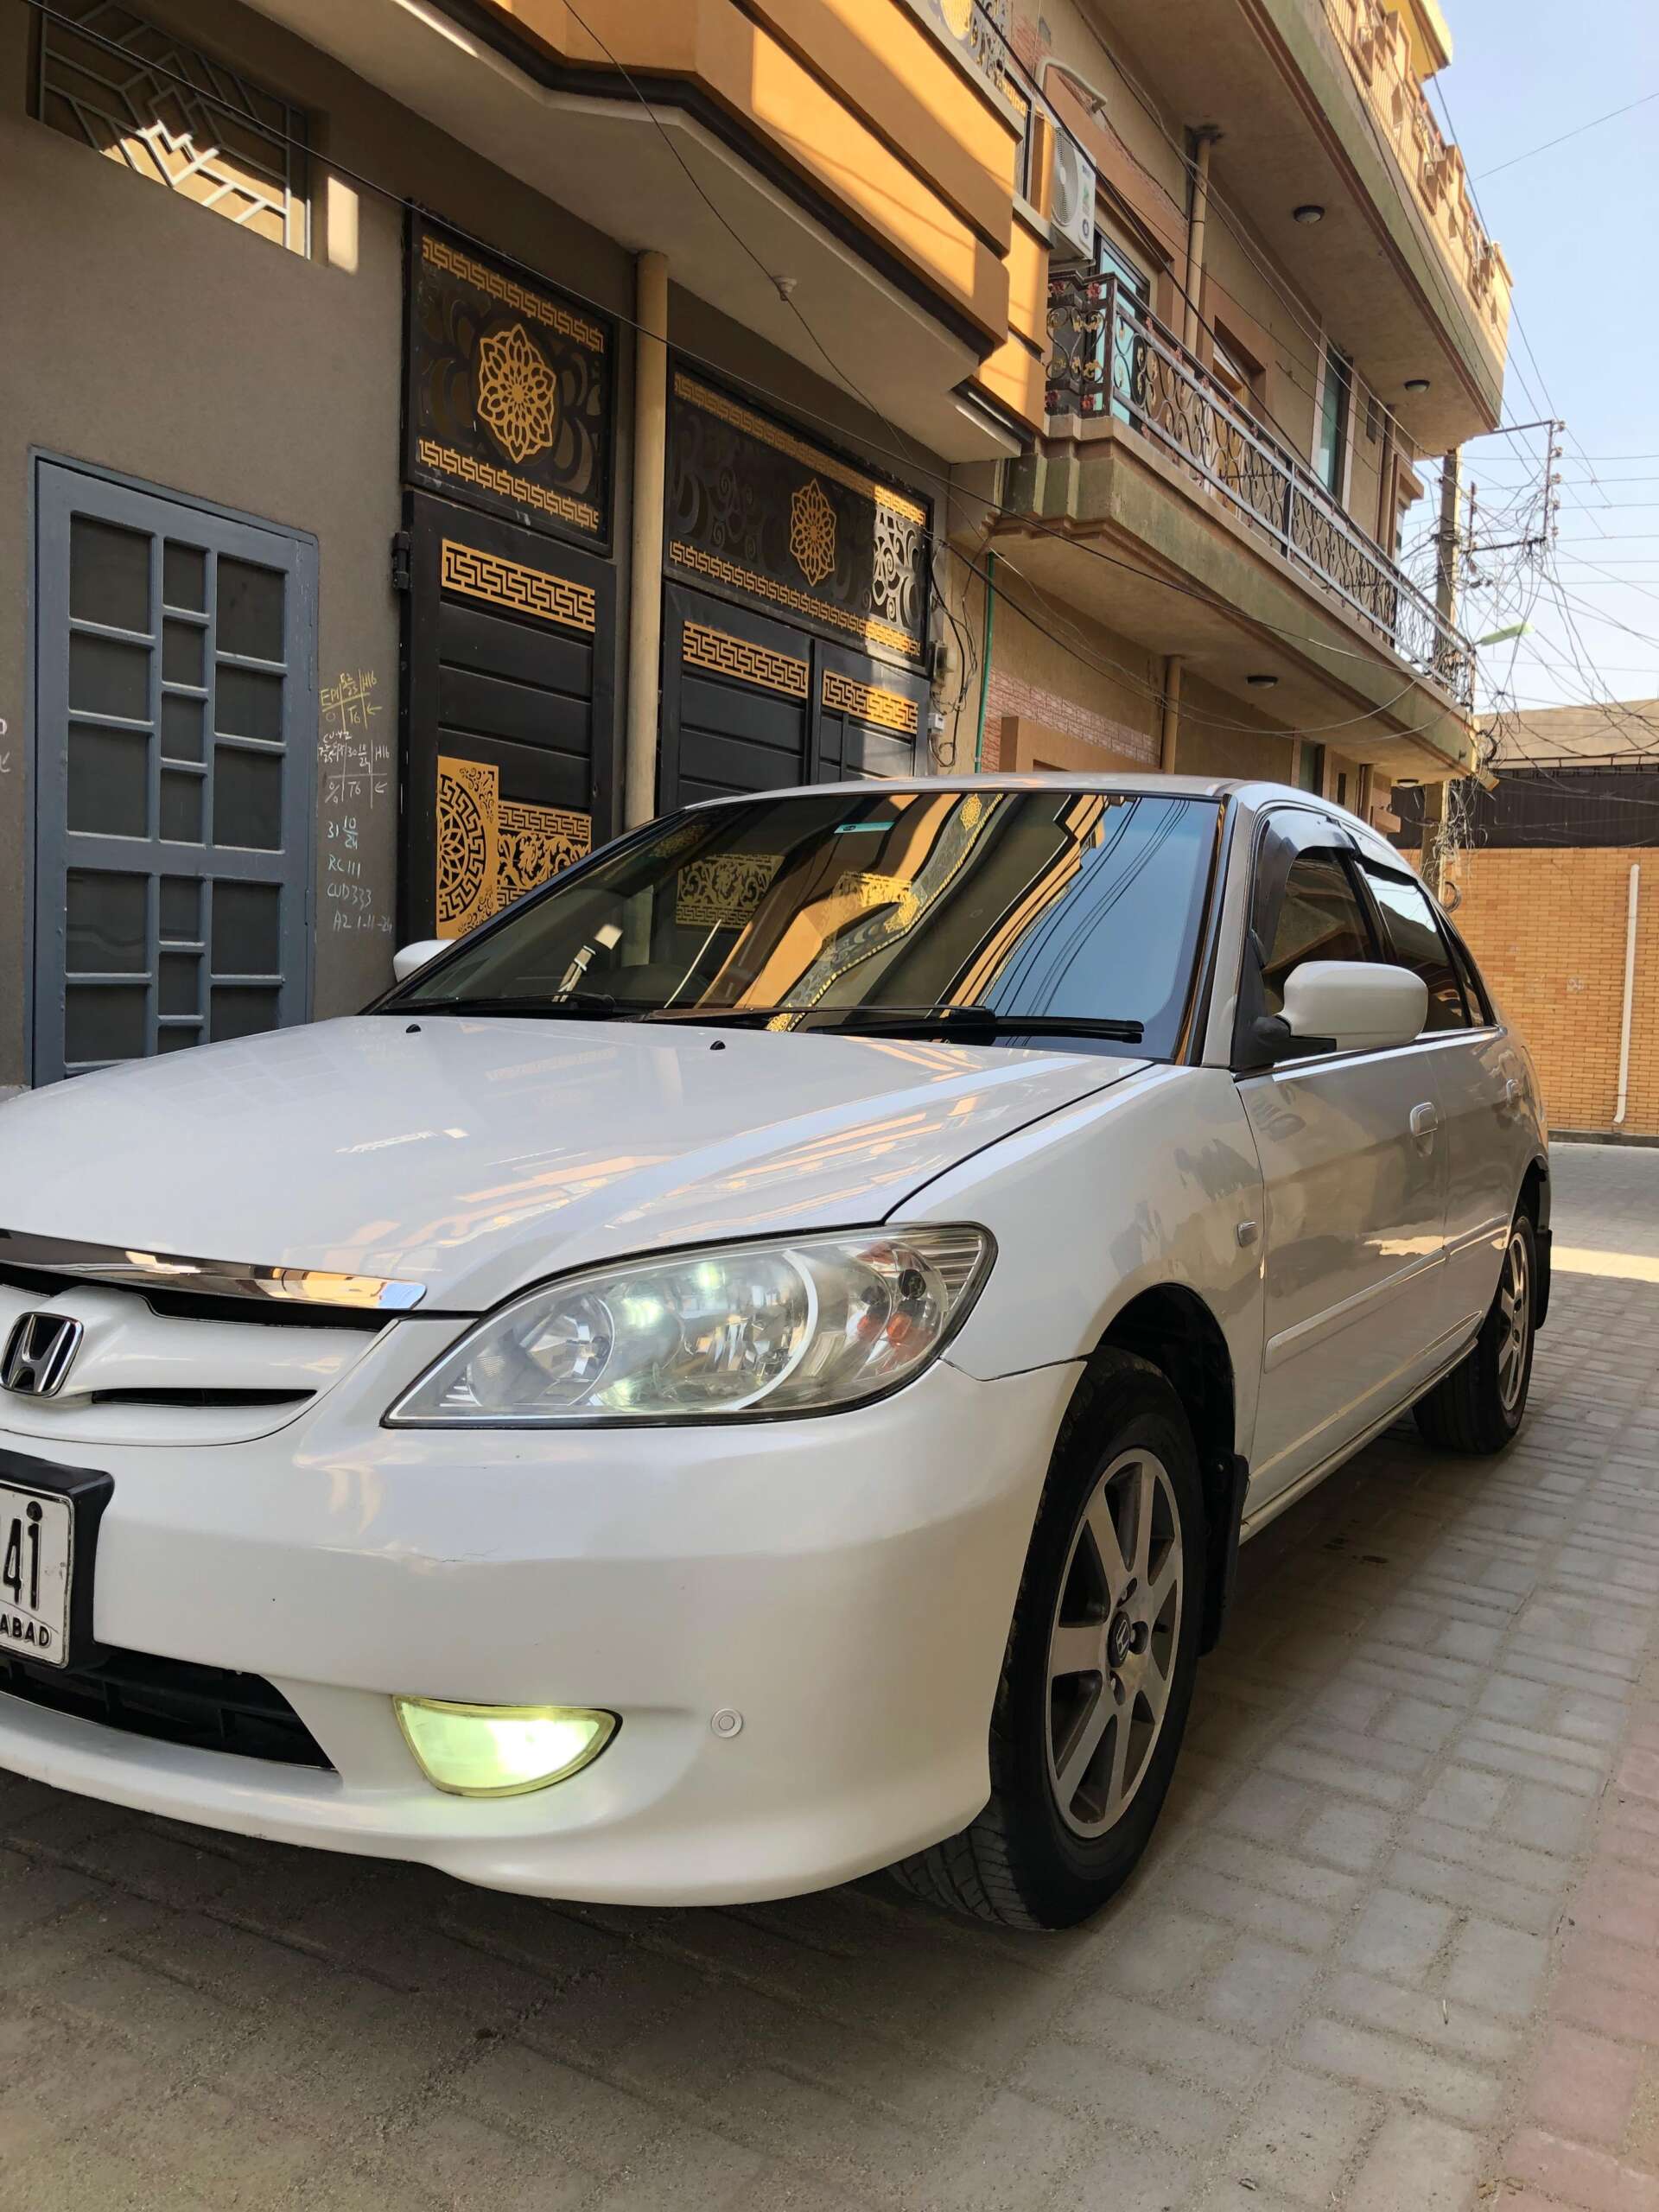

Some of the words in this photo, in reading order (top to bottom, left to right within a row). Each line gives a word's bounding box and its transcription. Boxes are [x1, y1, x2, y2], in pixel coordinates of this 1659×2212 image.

[347, 705, 361, 724] T6
[374, 744, 391, 761] H16
[347, 780, 361, 798] T6
[327, 821, 340, 838] 31
